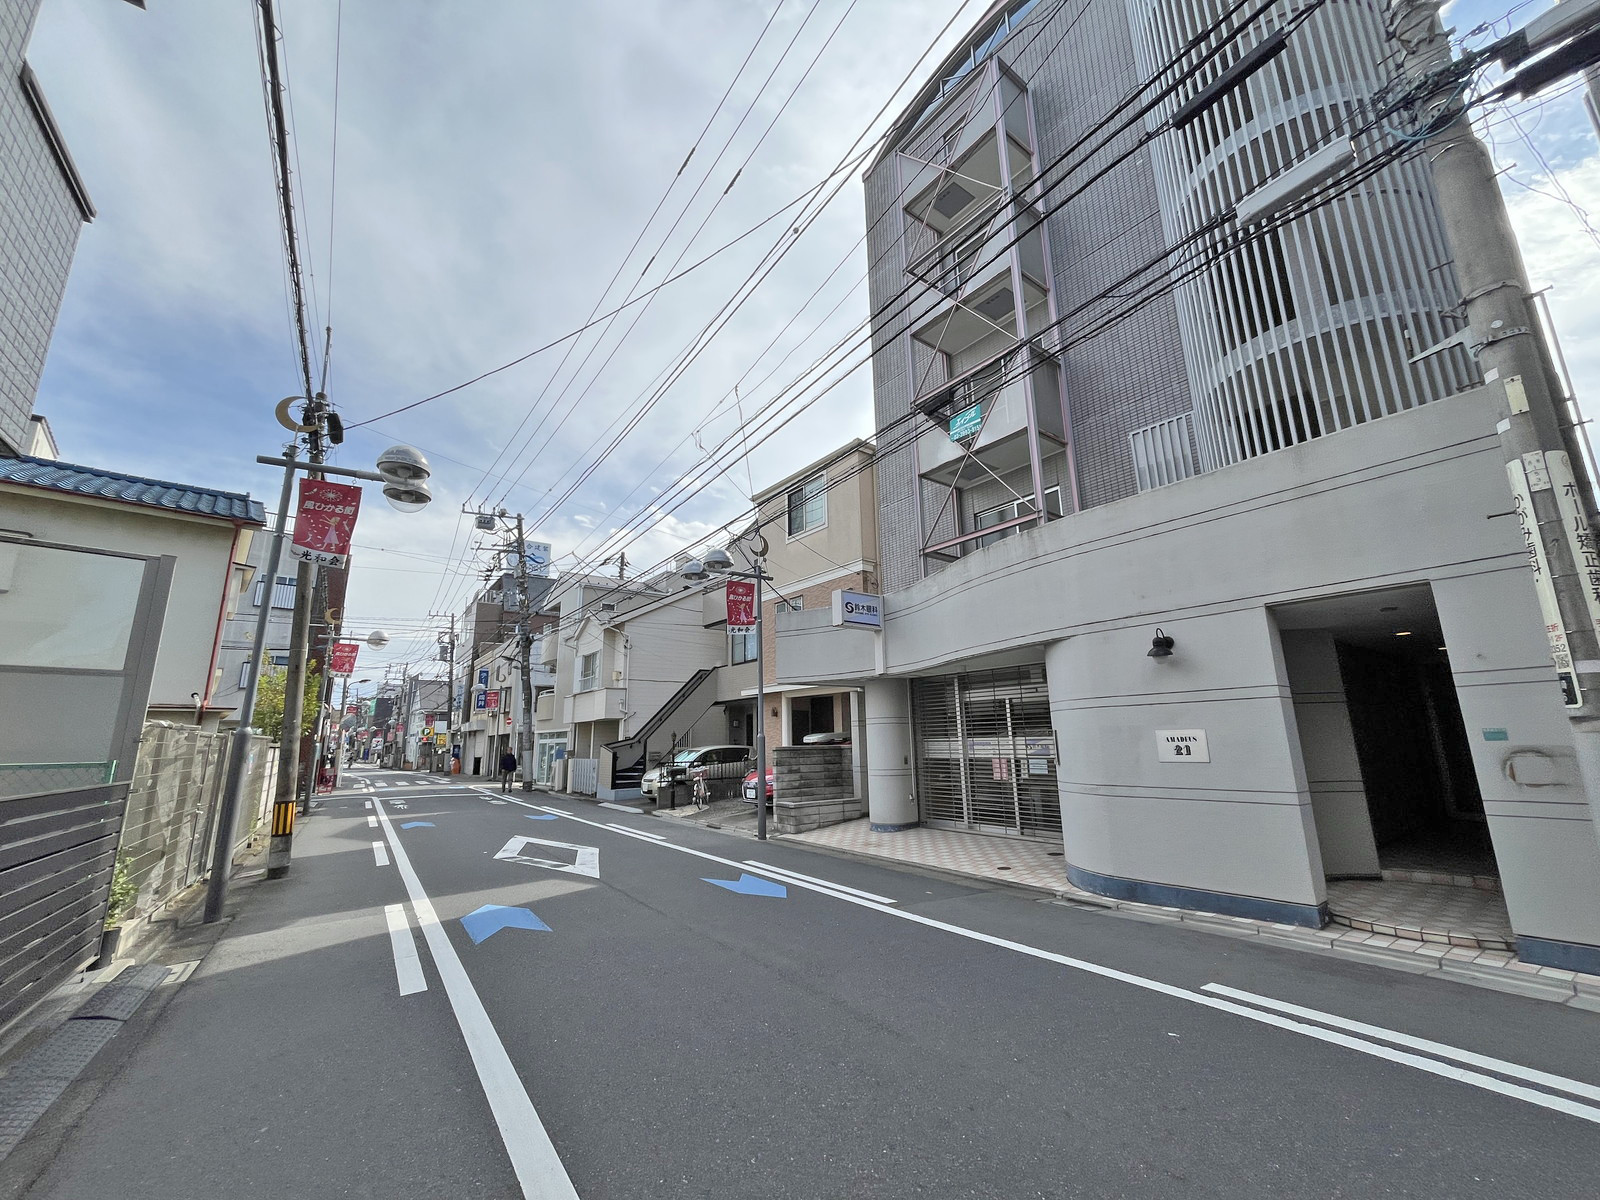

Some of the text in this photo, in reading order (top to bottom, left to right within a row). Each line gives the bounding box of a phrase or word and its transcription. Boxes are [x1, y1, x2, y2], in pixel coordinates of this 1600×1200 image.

[299, 550, 340, 566] 光和会
[1174, 744, 1192, 756] 21
